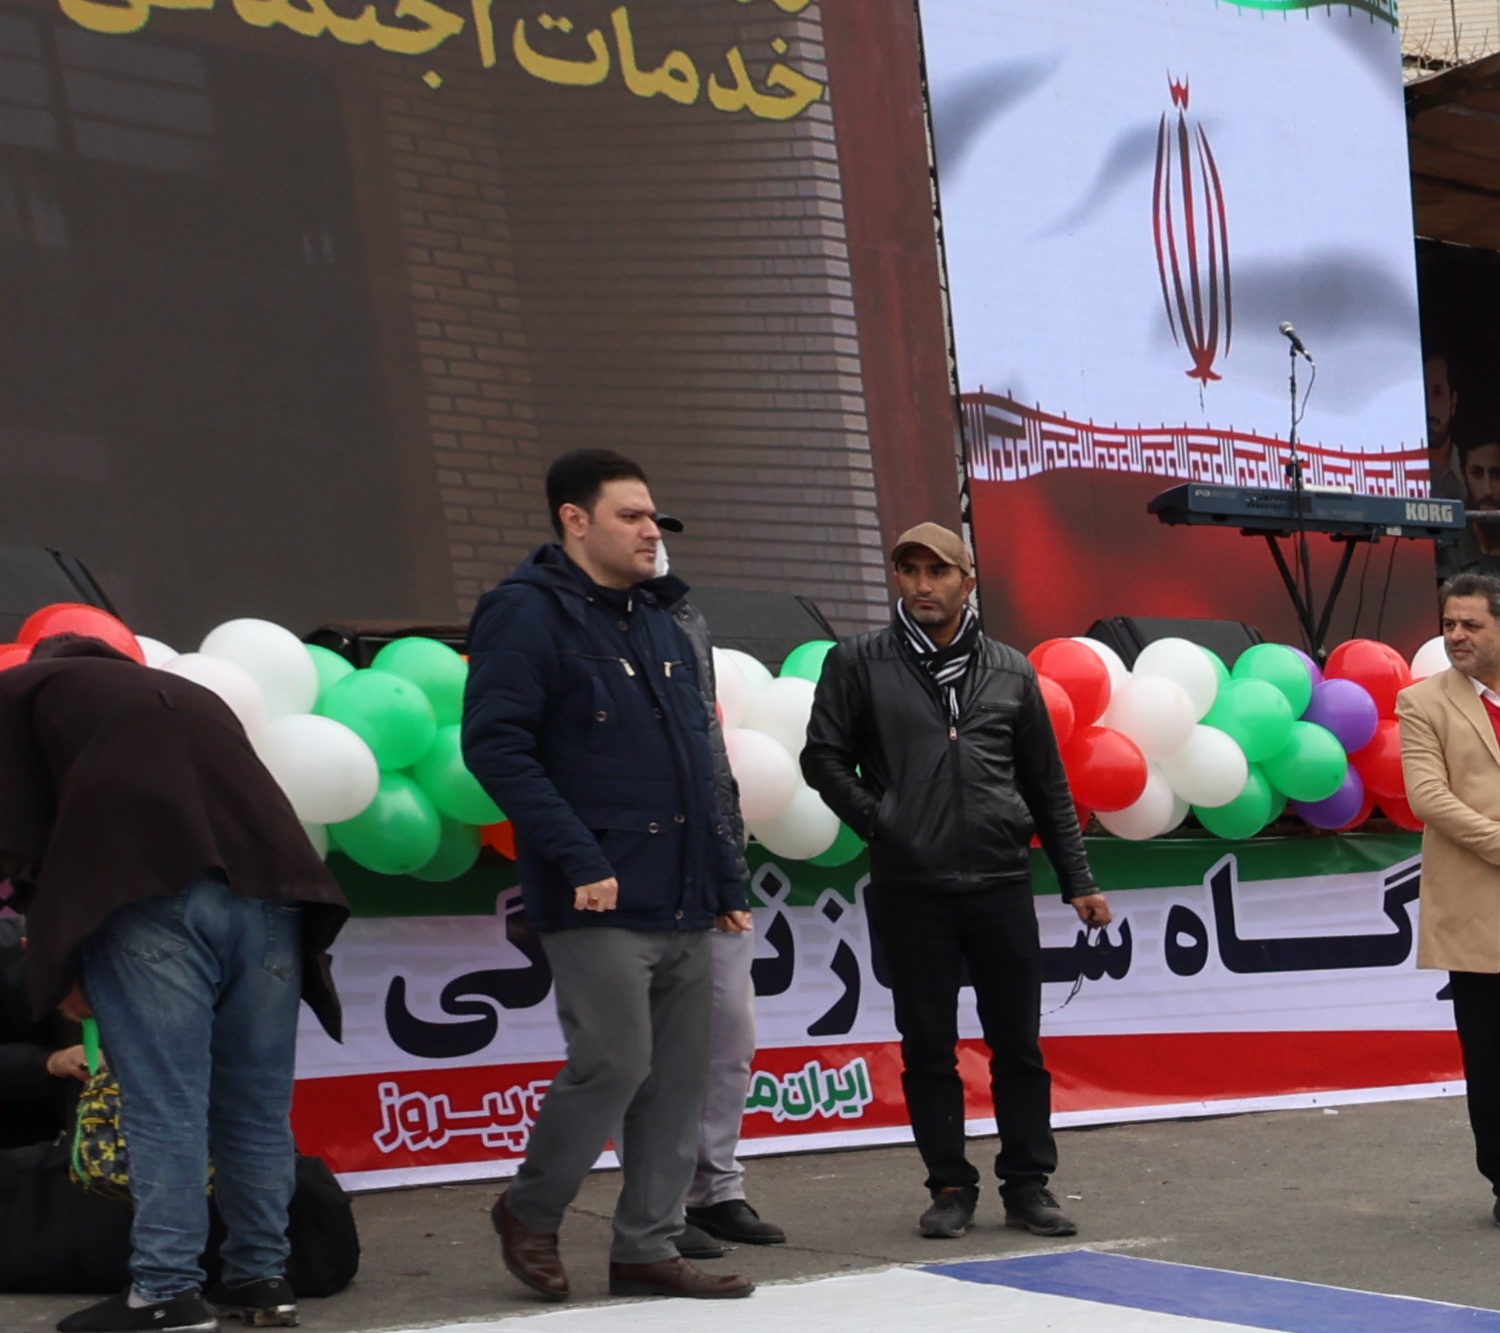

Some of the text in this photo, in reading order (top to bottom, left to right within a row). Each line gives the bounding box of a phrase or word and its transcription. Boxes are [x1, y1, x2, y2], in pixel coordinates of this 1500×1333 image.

[513, 8, 824, 120] خدمات
[1405, 502, 1453, 523] KORG
[373, 1081, 528, 1153] پیروز
